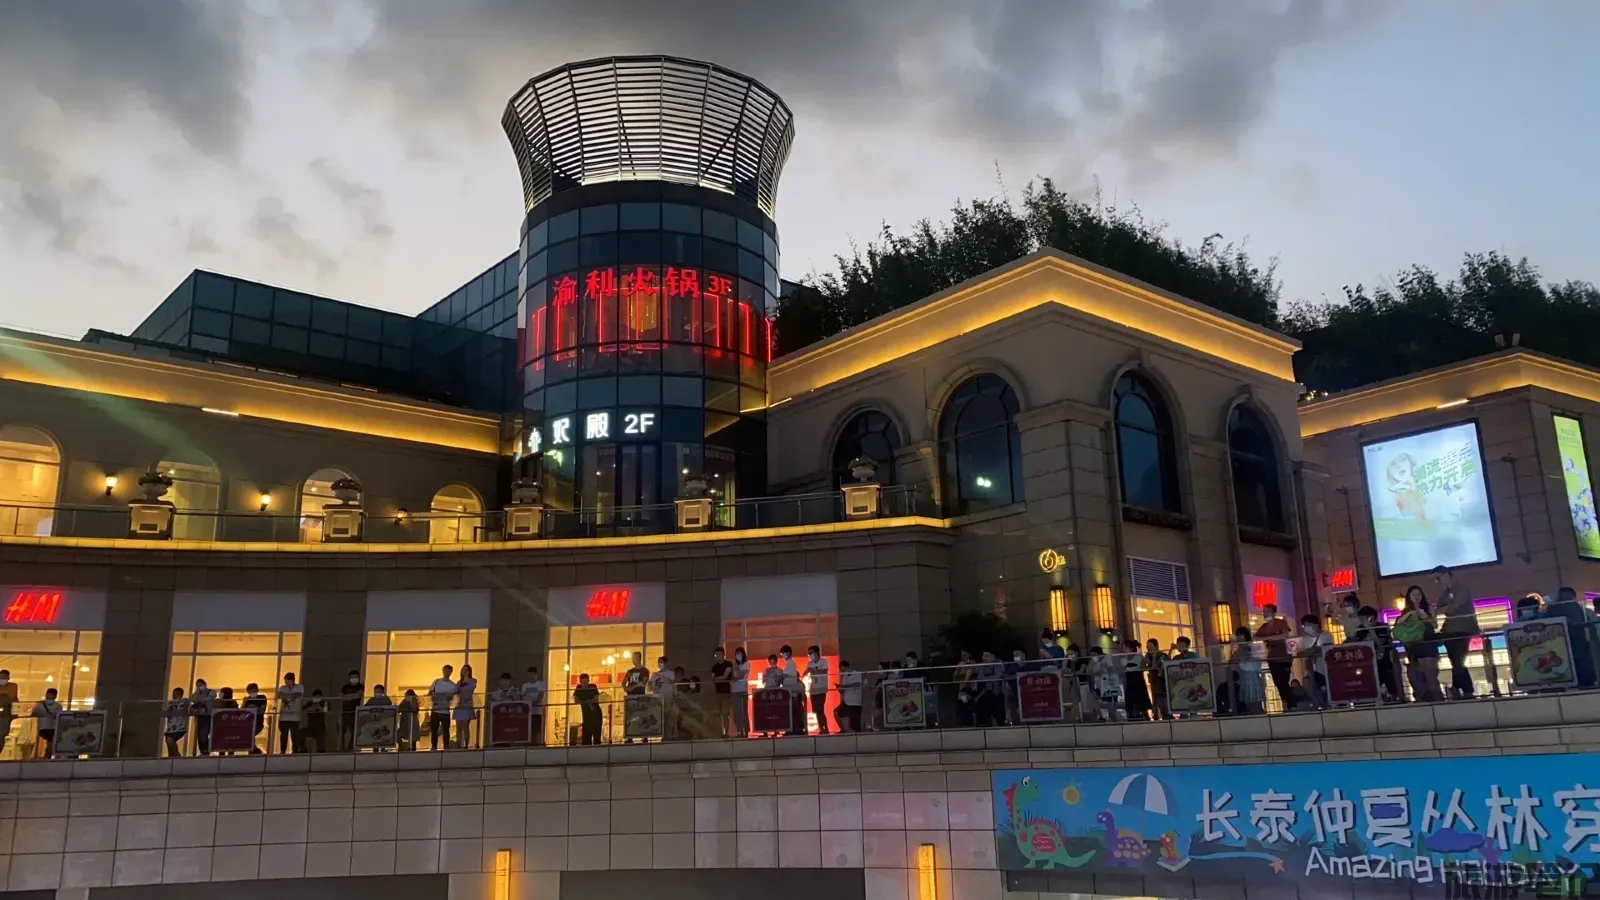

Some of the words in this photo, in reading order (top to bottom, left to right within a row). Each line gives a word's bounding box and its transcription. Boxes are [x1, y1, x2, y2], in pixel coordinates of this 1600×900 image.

[552, 266, 699, 307] 渝利火锅
[708, 275, 732, 295] 3F
[624, 413, 655, 434] 2F
[1305, 847, 1434, 884] Amazing
